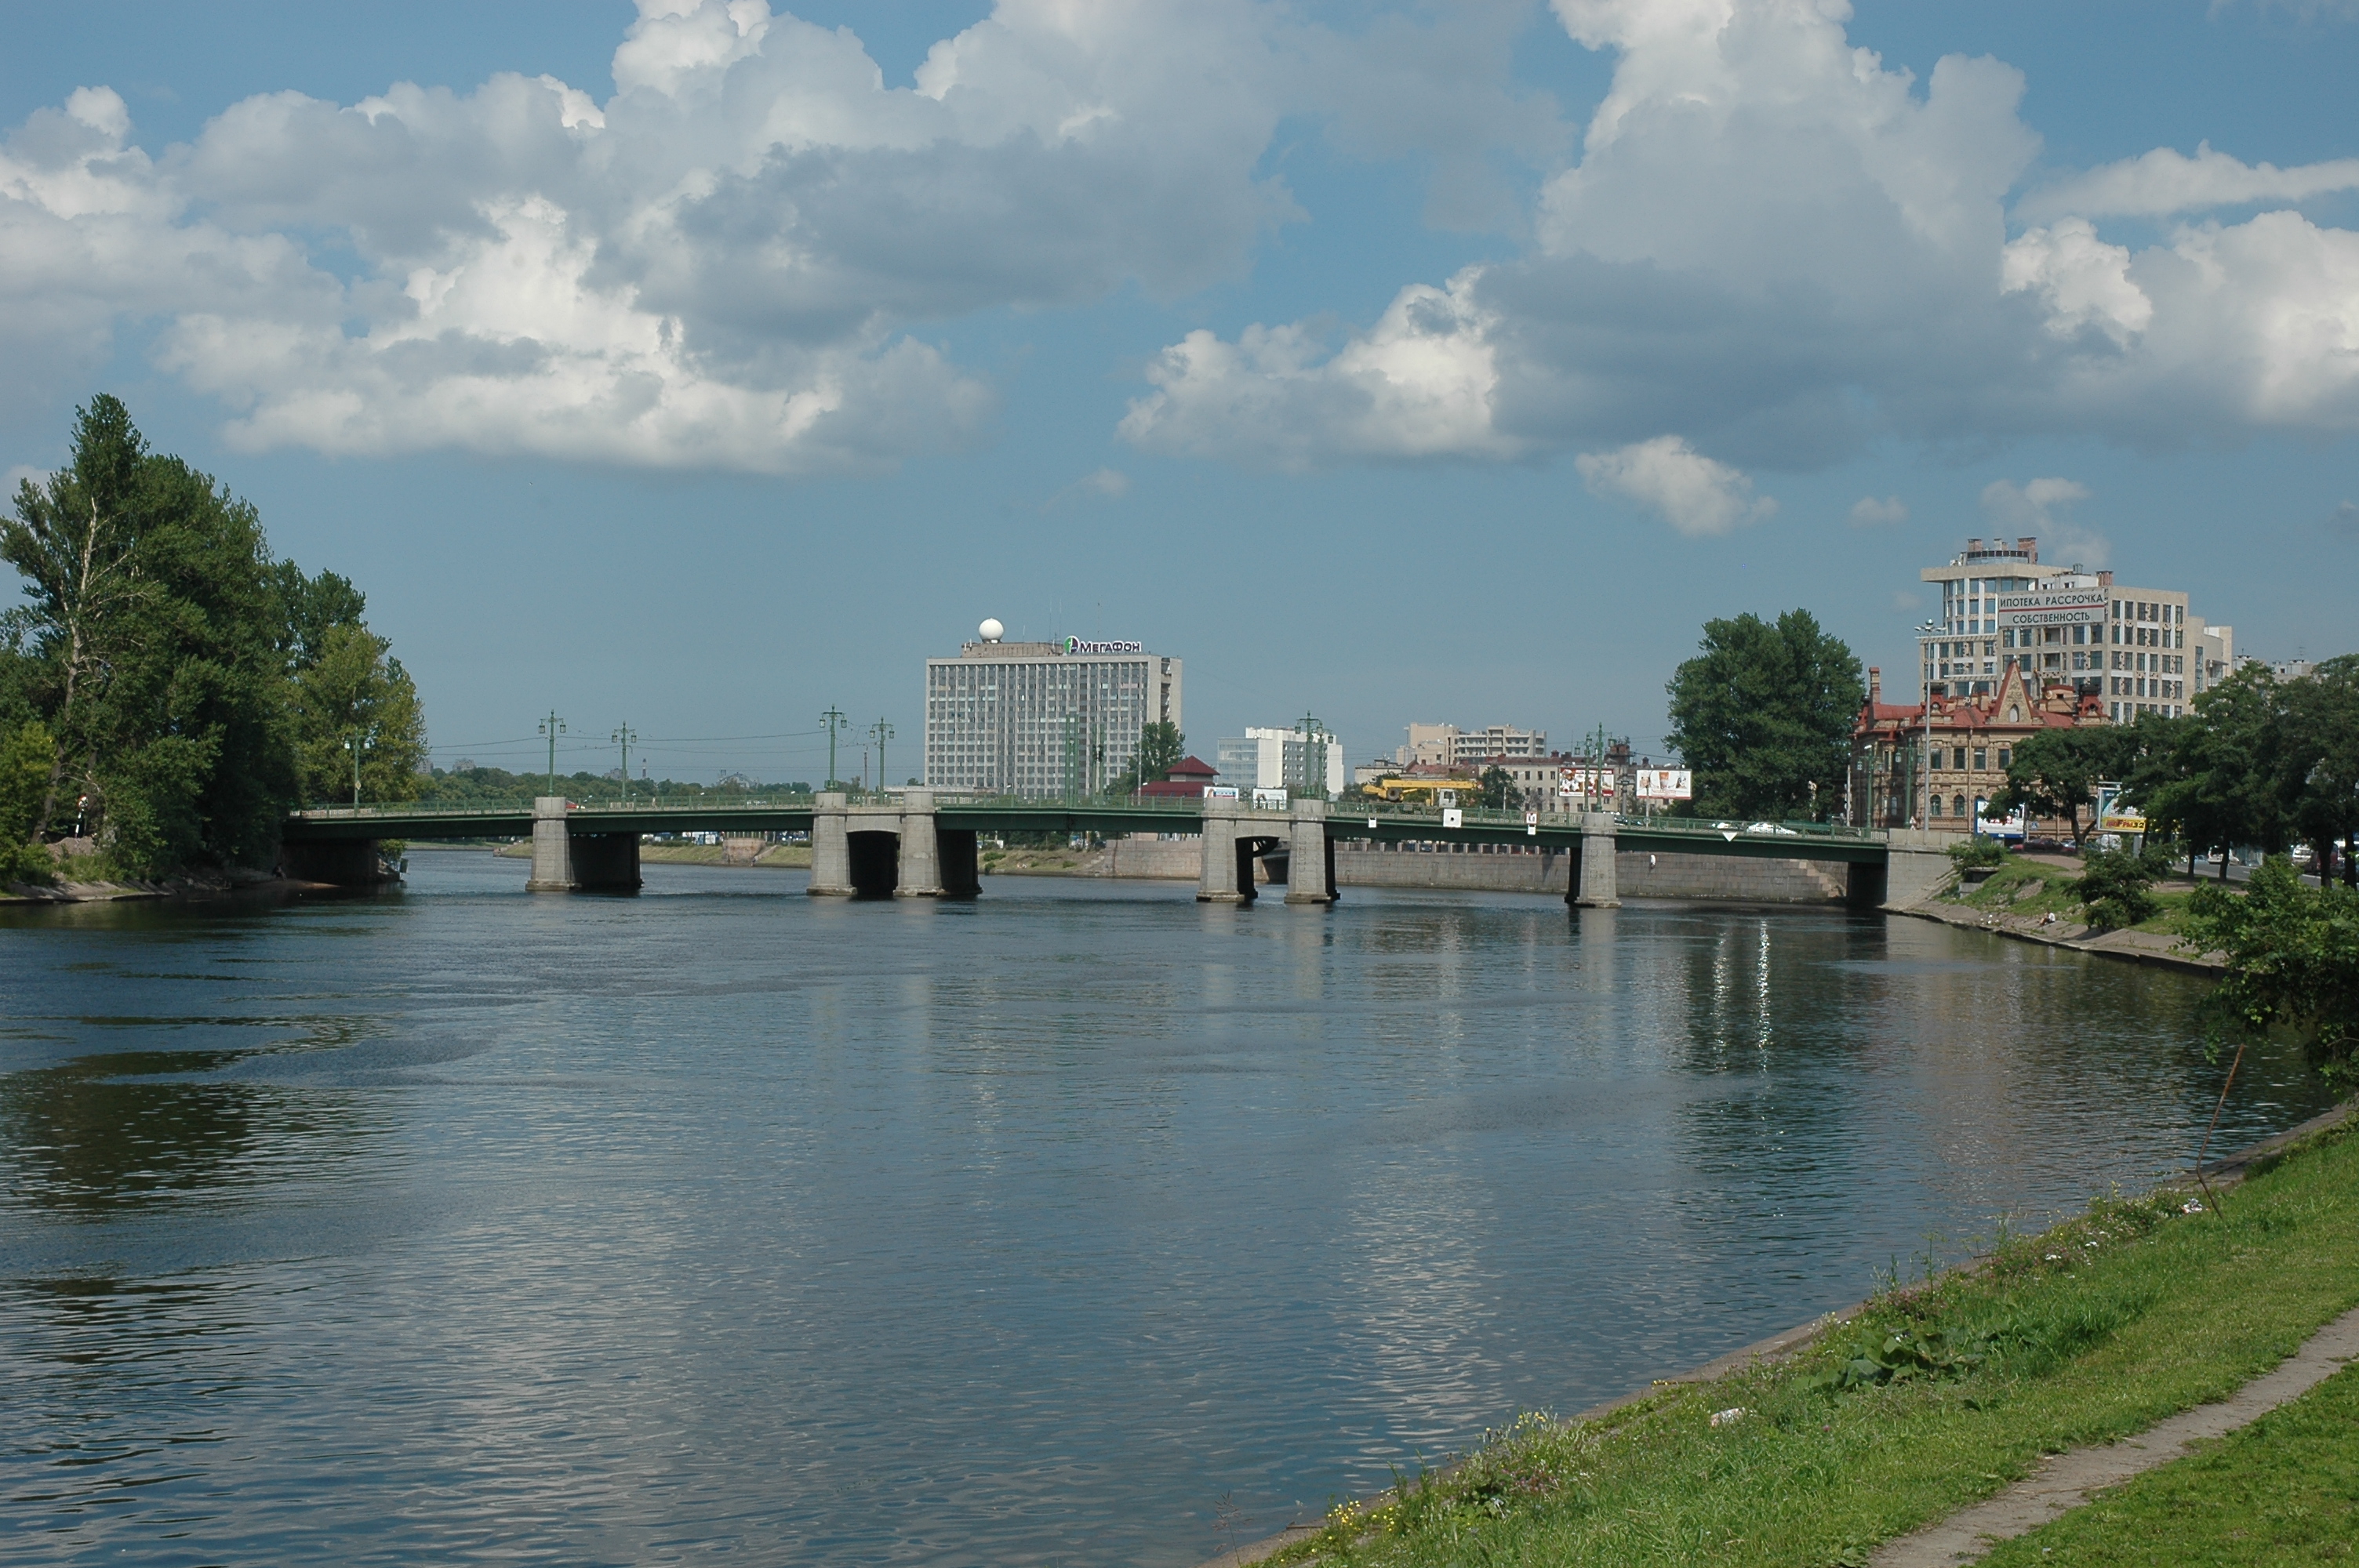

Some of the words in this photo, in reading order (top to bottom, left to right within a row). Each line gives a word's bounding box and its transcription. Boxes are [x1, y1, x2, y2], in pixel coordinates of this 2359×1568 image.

[2001, 598, 2040, 607] ИПОТЕКА
[2045, 594, 2103, 605] РАССРОЧКА
[2012, 613, 2090, 623] СОБСТВЕННОСТЬ
